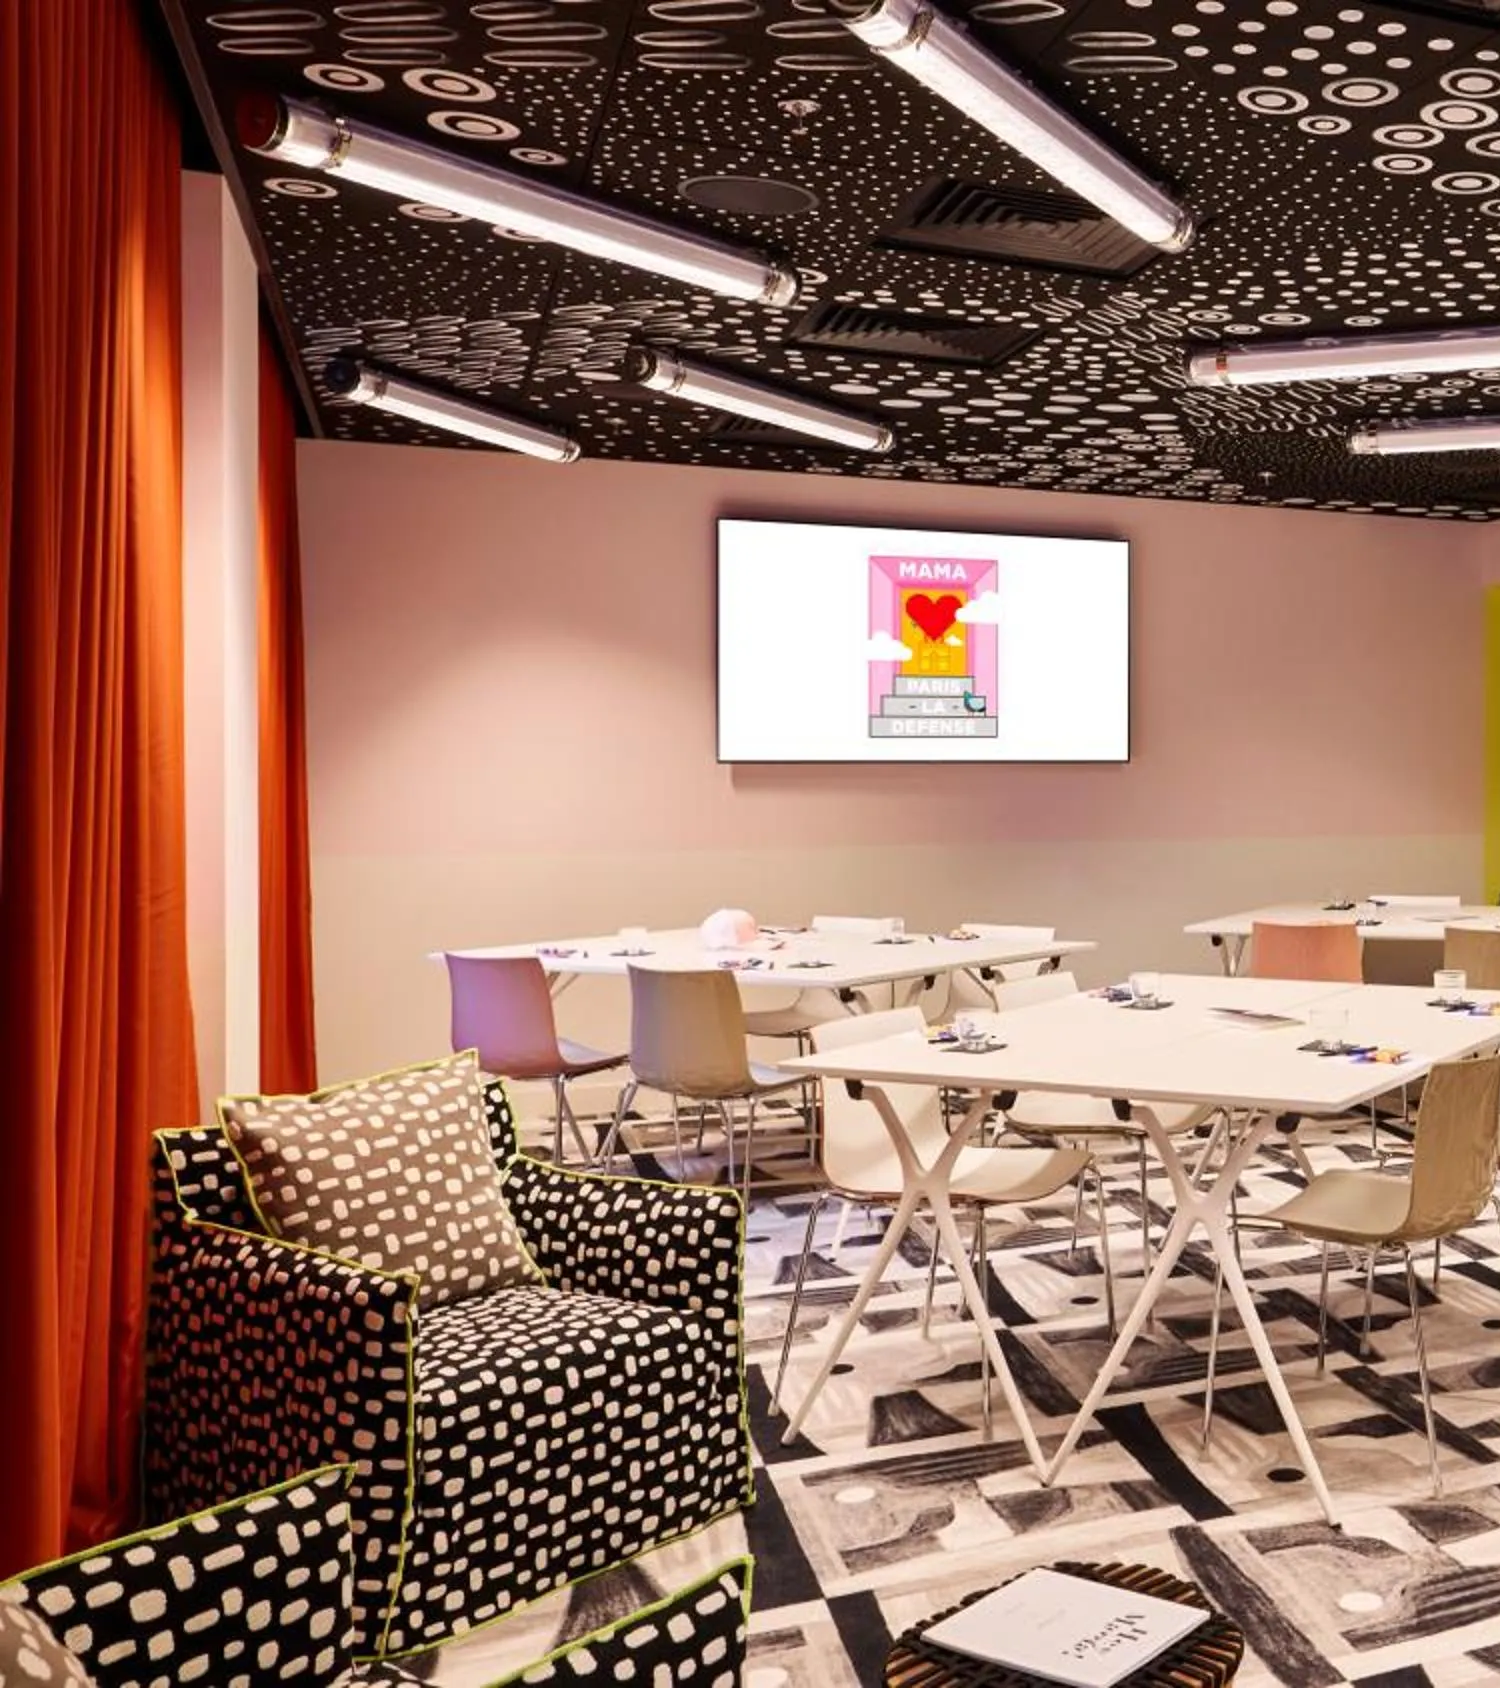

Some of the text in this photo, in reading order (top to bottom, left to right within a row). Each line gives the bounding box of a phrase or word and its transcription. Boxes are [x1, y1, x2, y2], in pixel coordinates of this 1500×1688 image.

[899, 562, 968, 580] MAMA
[906, 678, 961, 694] PARIS
[922, 699, 946, 714] LA
